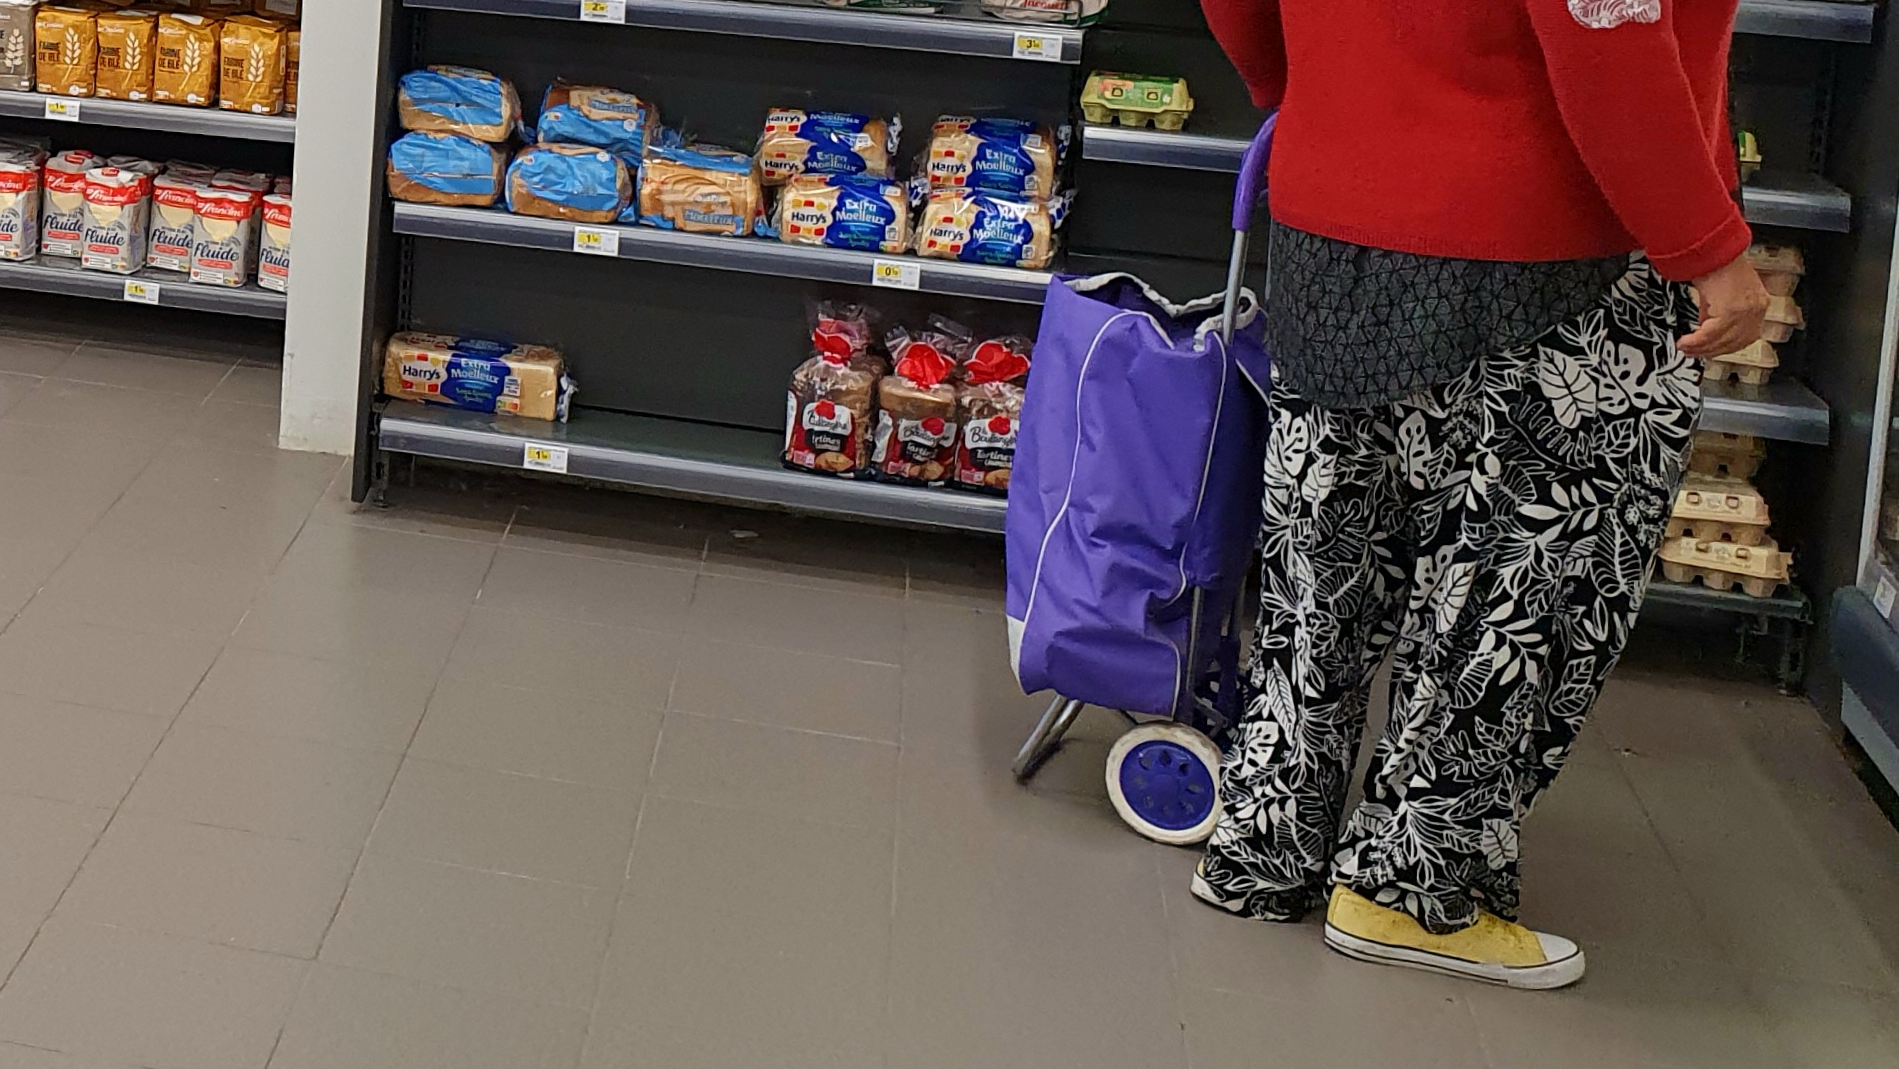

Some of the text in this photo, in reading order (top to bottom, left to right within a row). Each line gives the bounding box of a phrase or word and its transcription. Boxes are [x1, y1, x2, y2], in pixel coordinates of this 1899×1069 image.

[158, 57, 181, 69] DE BLÉ
[816, 151, 848, 162] Extra
[764, 158, 800, 172] Harry's
[807, 159, 859, 173] Moelleux
[931, 161, 967, 174] Harry's
[975, 160, 1025, 176] Moelleux
[845, 198, 877, 212] Extra
[791, 211, 827, 225] Harry's
[835, 209, 887, 226] Moelleux
[983, 216, 1016, 231] Extra
[84, 227, 125, 248] Fluide
[151, 228, 194, 249] Fluide
[929, 227, 964, 242] Harry's
[194, 240, 239, 263] Fluide
[461, 358, 491, 370] Extra
[402, 364, 441, 380] Harry's
[450, 368, 500, 384] Moelleux
